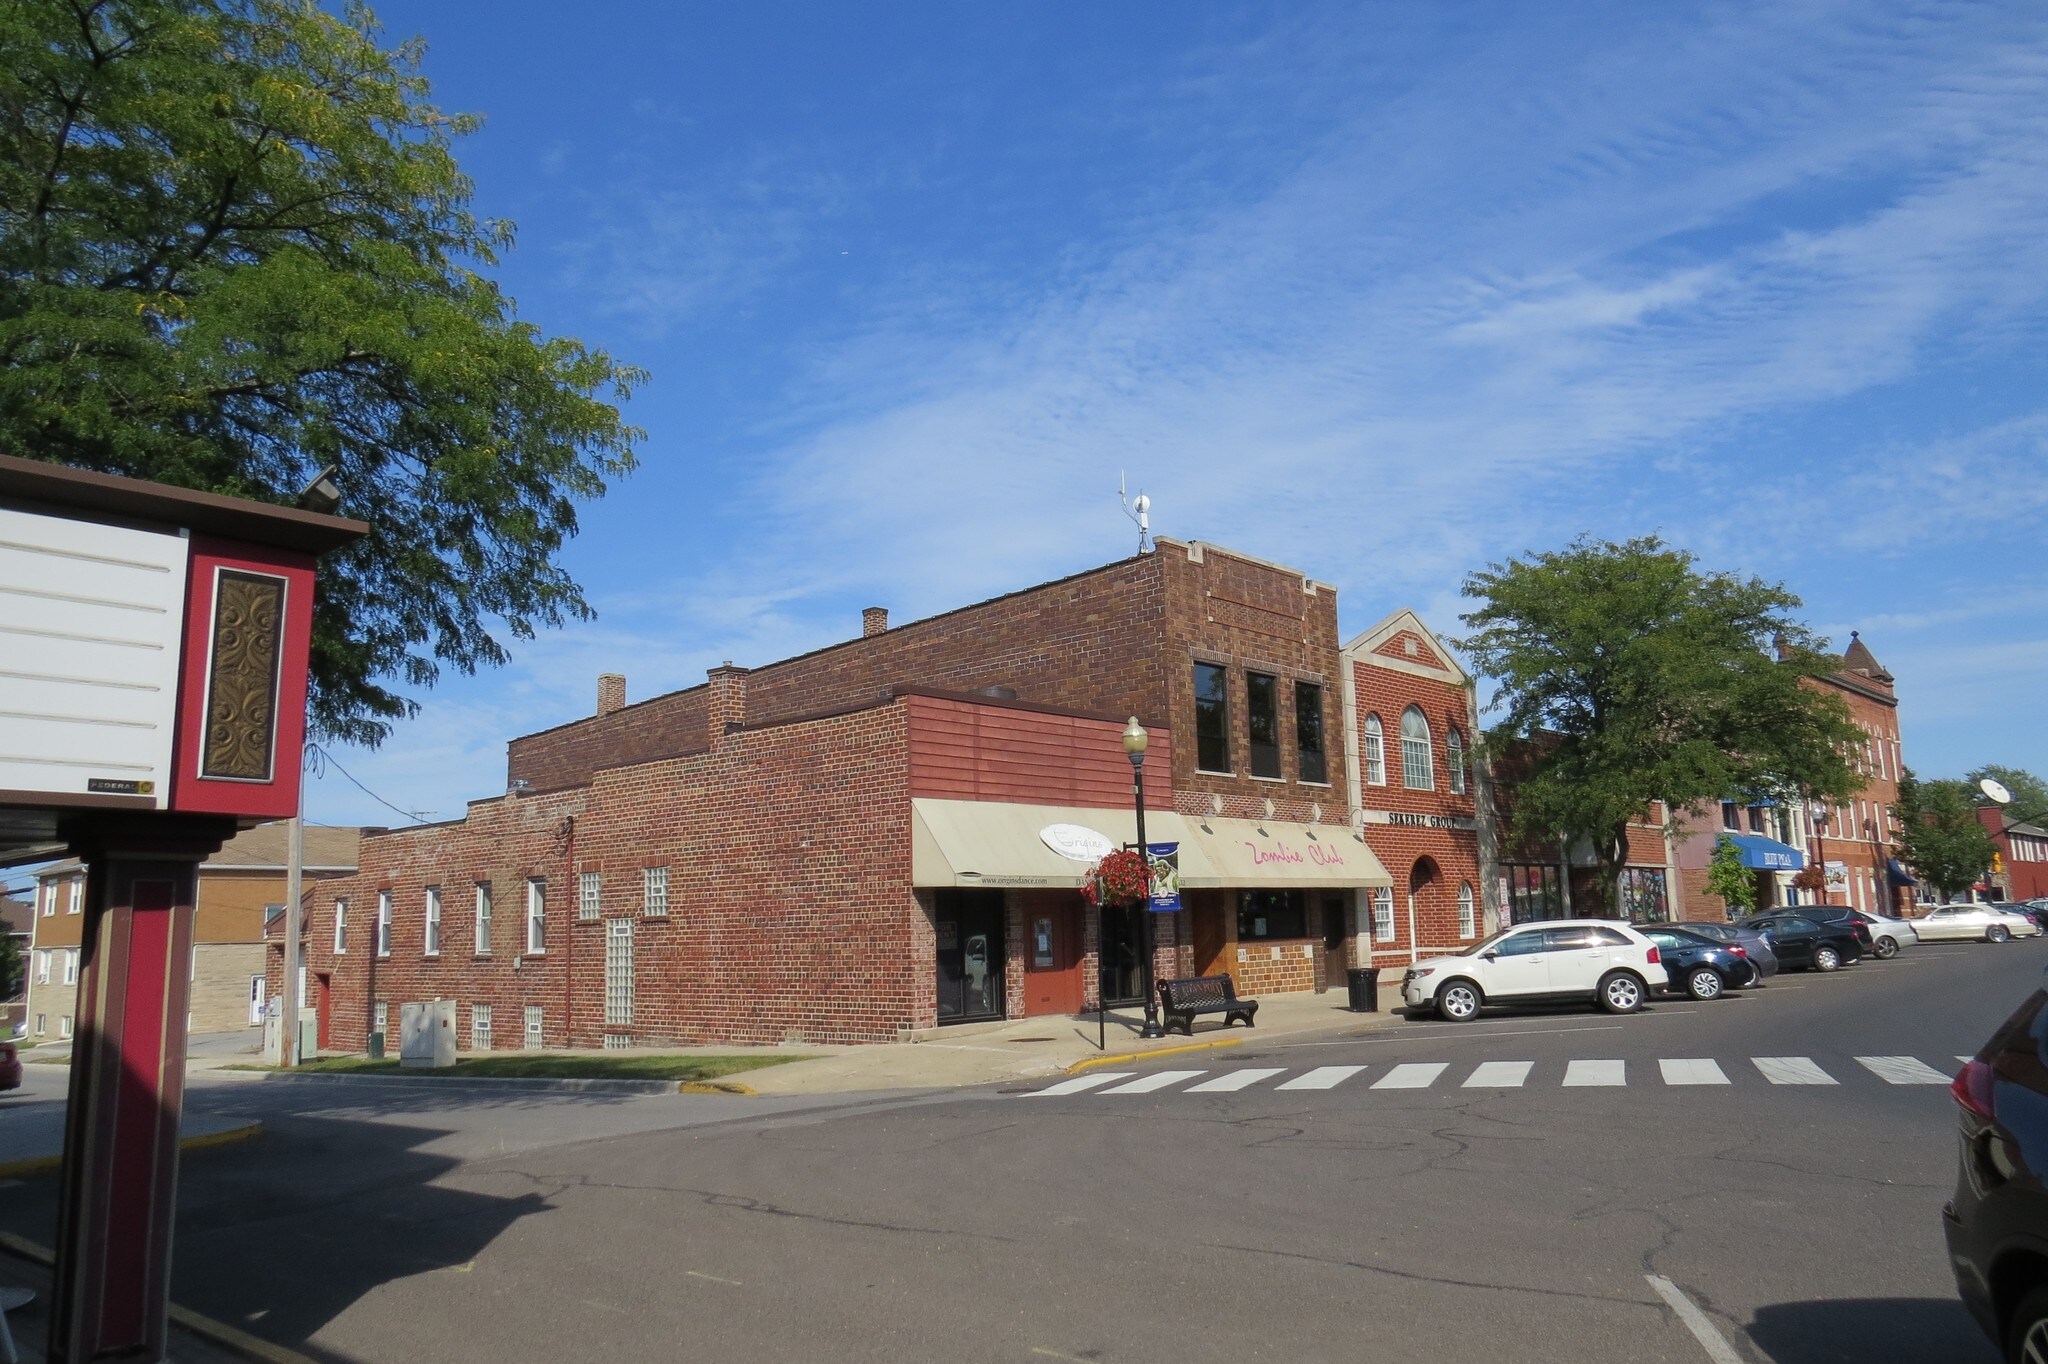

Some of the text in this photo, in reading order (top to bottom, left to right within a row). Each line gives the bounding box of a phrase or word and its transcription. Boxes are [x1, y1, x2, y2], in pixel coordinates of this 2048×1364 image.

[1388, 812, 1456, 829] SEKEREZ GROUP
[1244, 841, 1344, 867] Zombie Club
[981, 876, 1048, 887] www.originsdance.com
